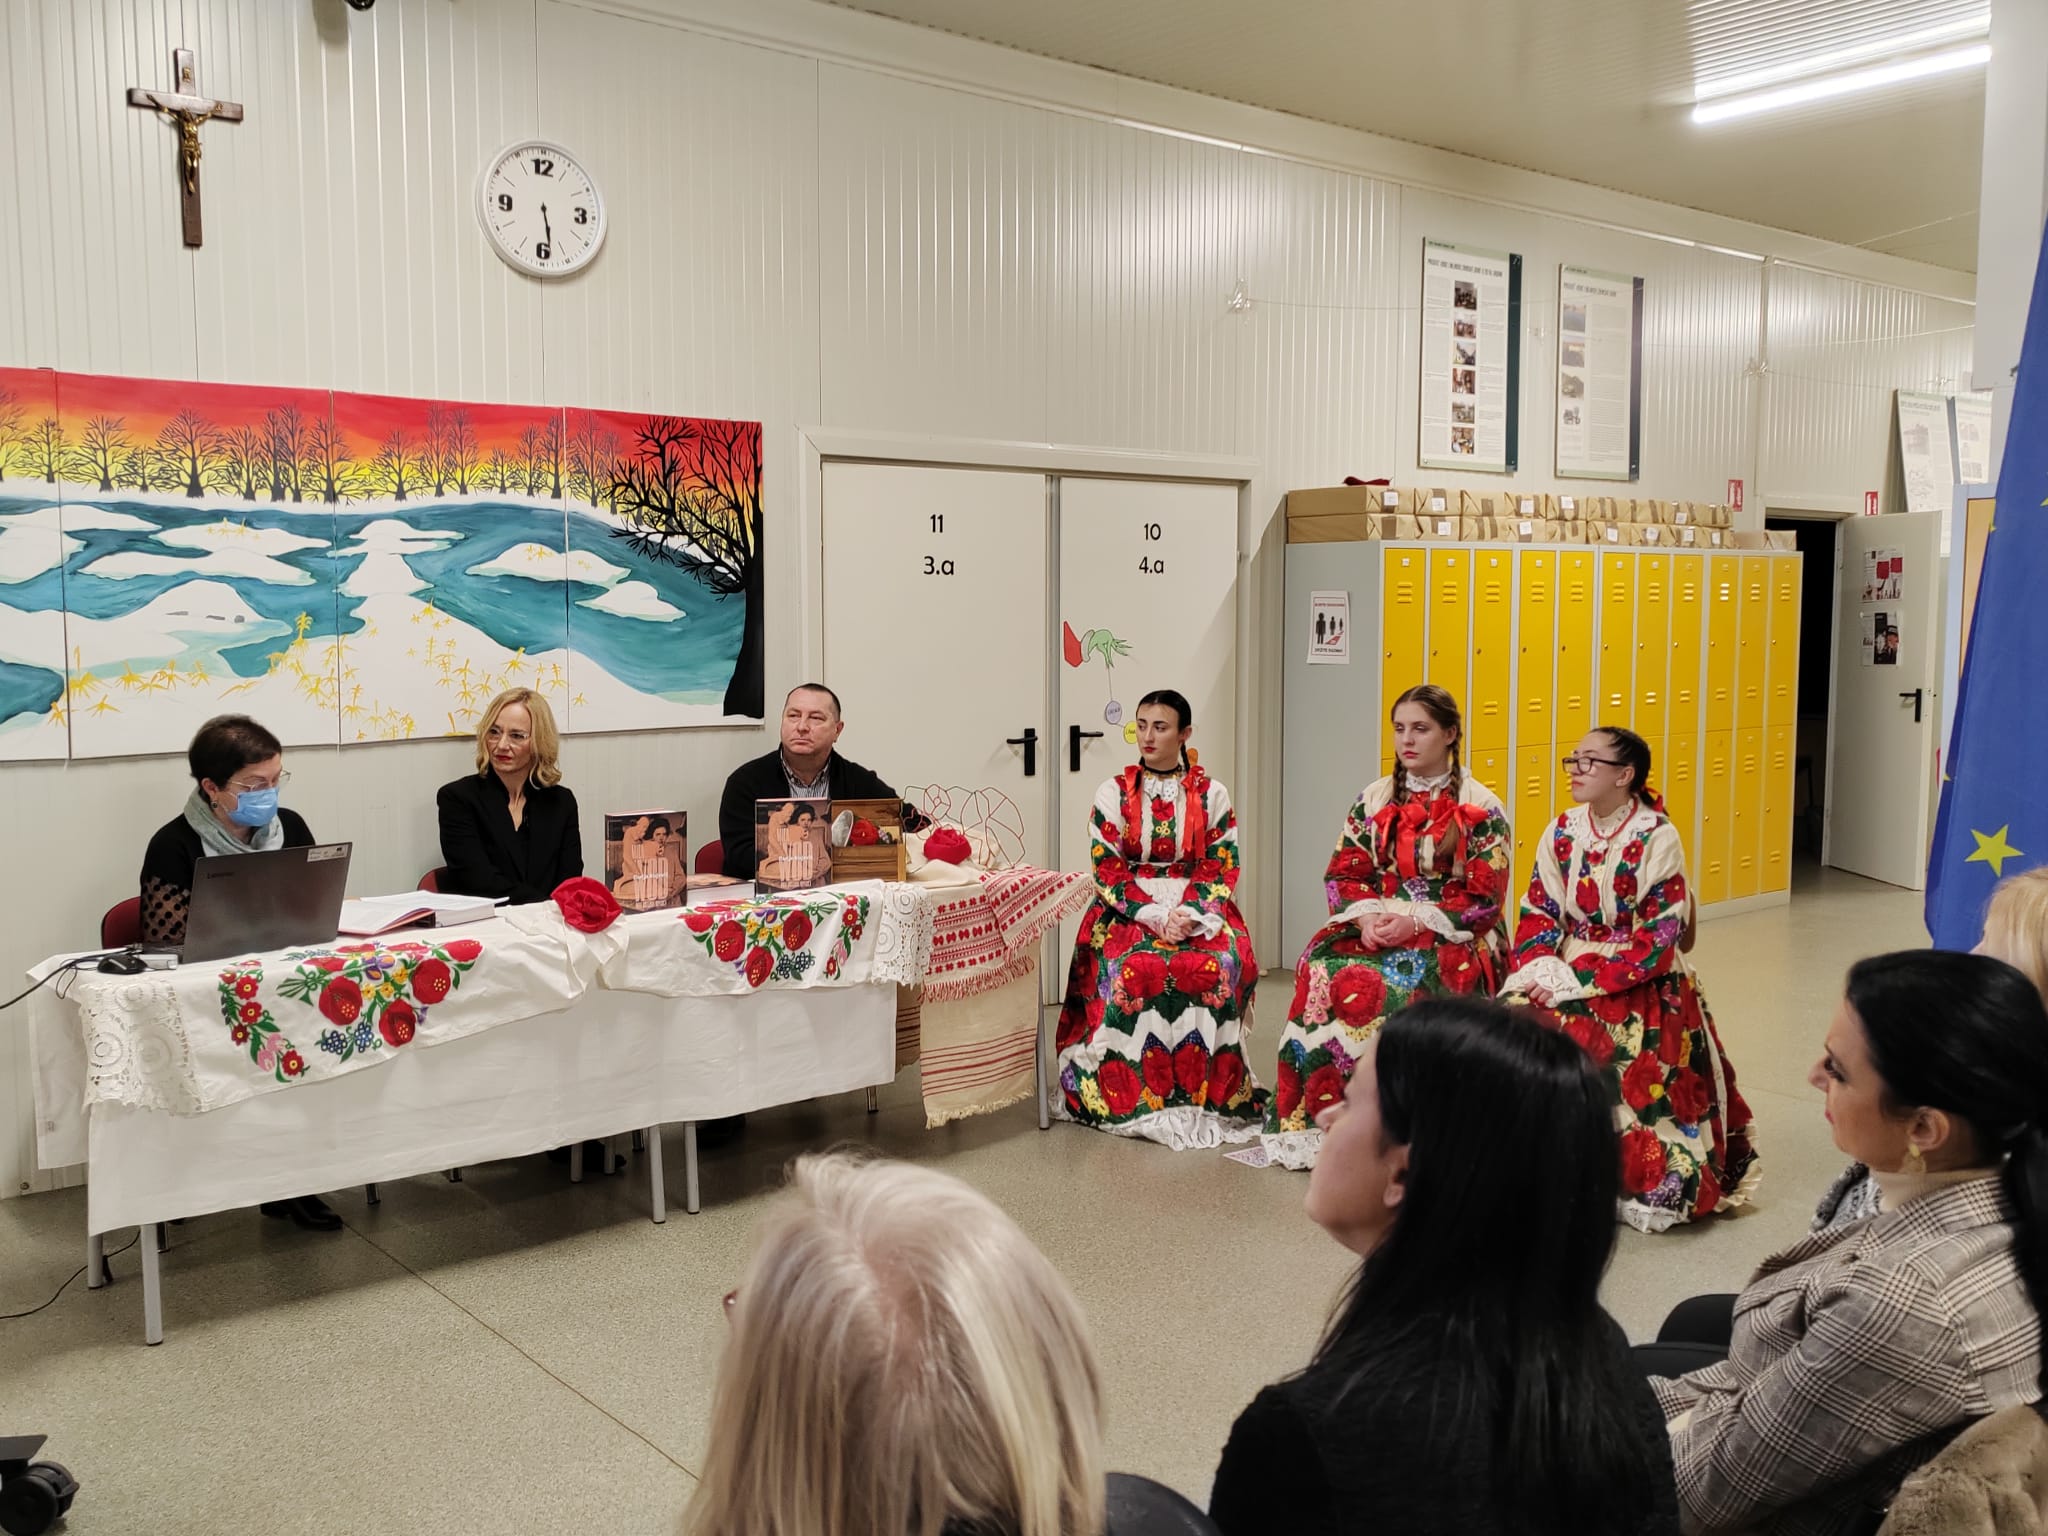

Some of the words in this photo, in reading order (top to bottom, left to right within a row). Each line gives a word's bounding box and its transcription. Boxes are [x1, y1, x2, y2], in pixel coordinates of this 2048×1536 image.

[531, 158, 554, 178] 12
[498, 194, 513, 212] 9
[574, 207, 588, 225] 3
[536, 242, 551, 260] 6
[929, 513, 944, 533] 11
[1143, 522, 1162, 541] 10
[923, 556, 955, 575] 3.a
[1138, 556, 1165, 574] 4.a
